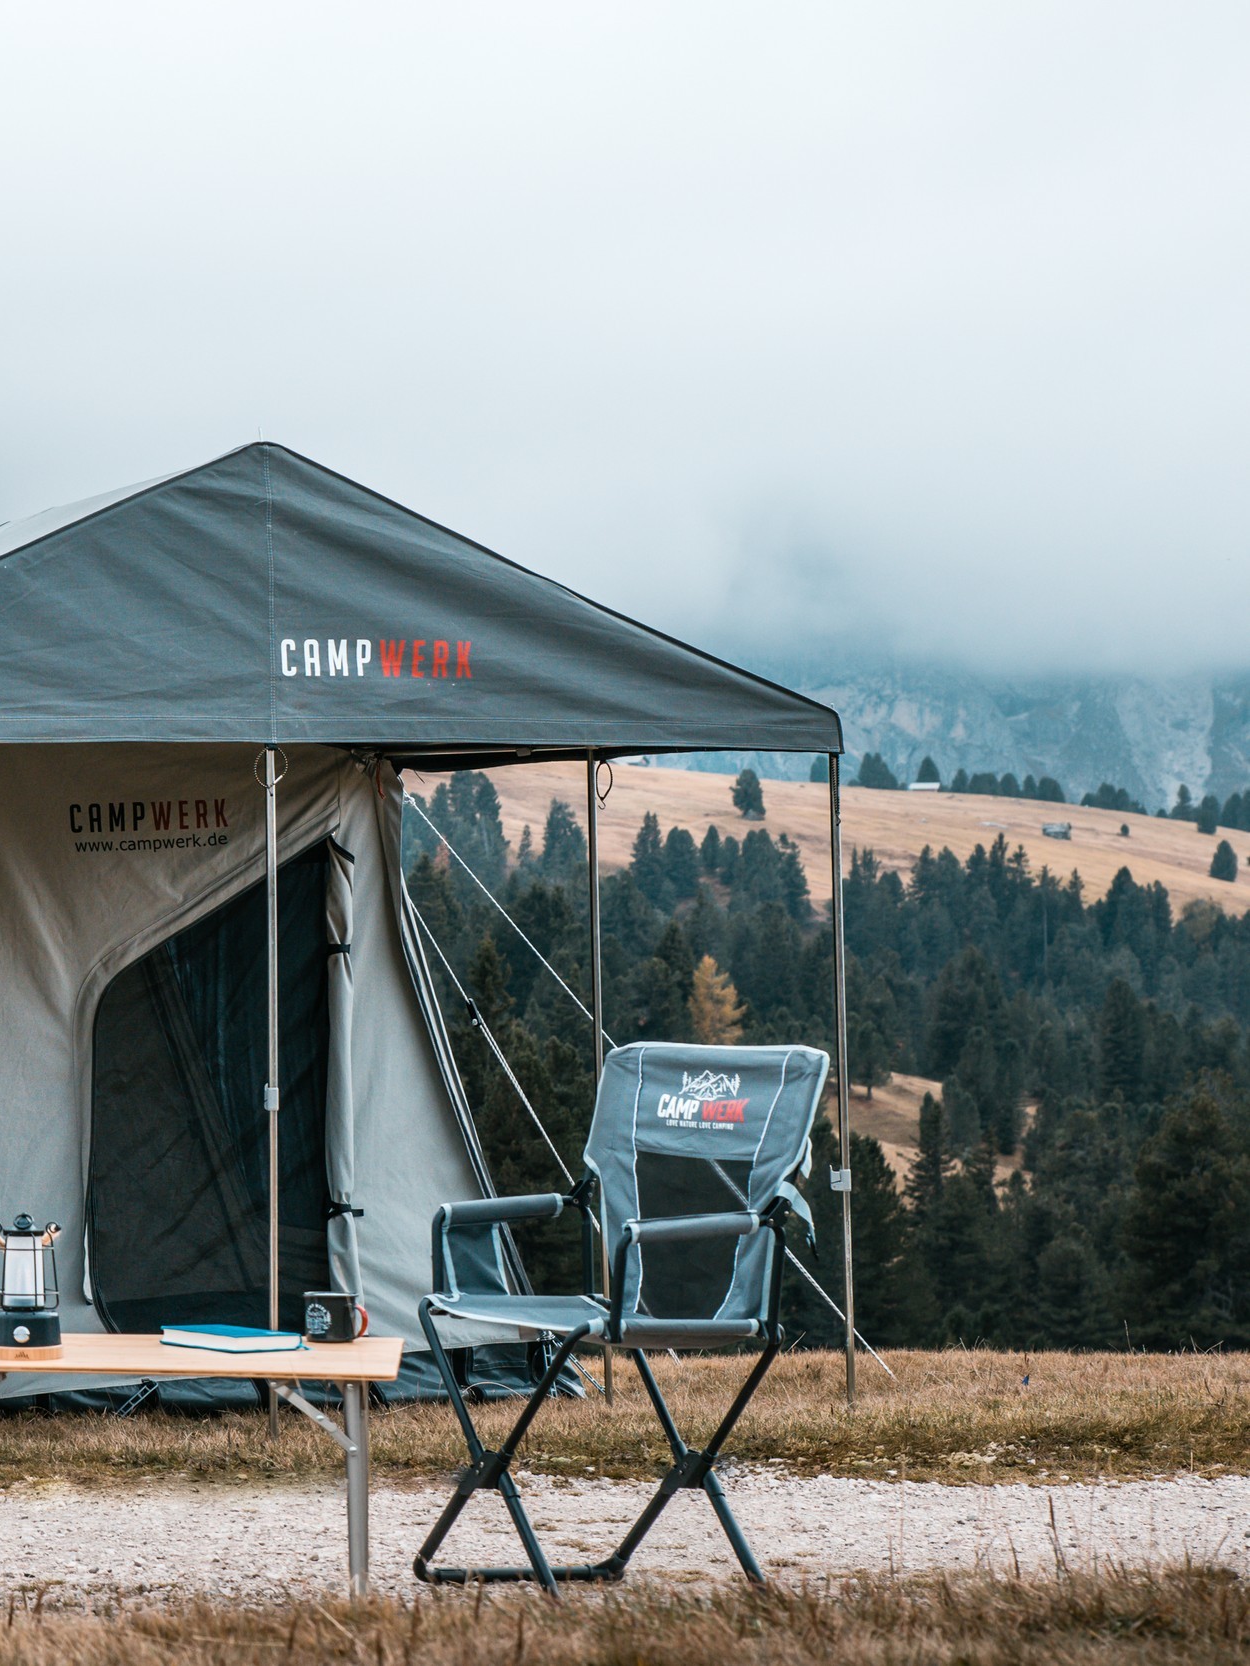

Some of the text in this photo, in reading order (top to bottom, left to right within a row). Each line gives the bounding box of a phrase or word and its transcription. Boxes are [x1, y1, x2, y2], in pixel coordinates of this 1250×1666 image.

[280, 638, 473, 679] CAMPWERK
[69, 798, 229, 834] CAMPWERK
[74, 832, 228, 853] www.campwerk.de
[657, 1093, 750, 1123] CAMP WERK
[666, 1119, 735, 1131] LOVE NATURE LOVE CAMPING
